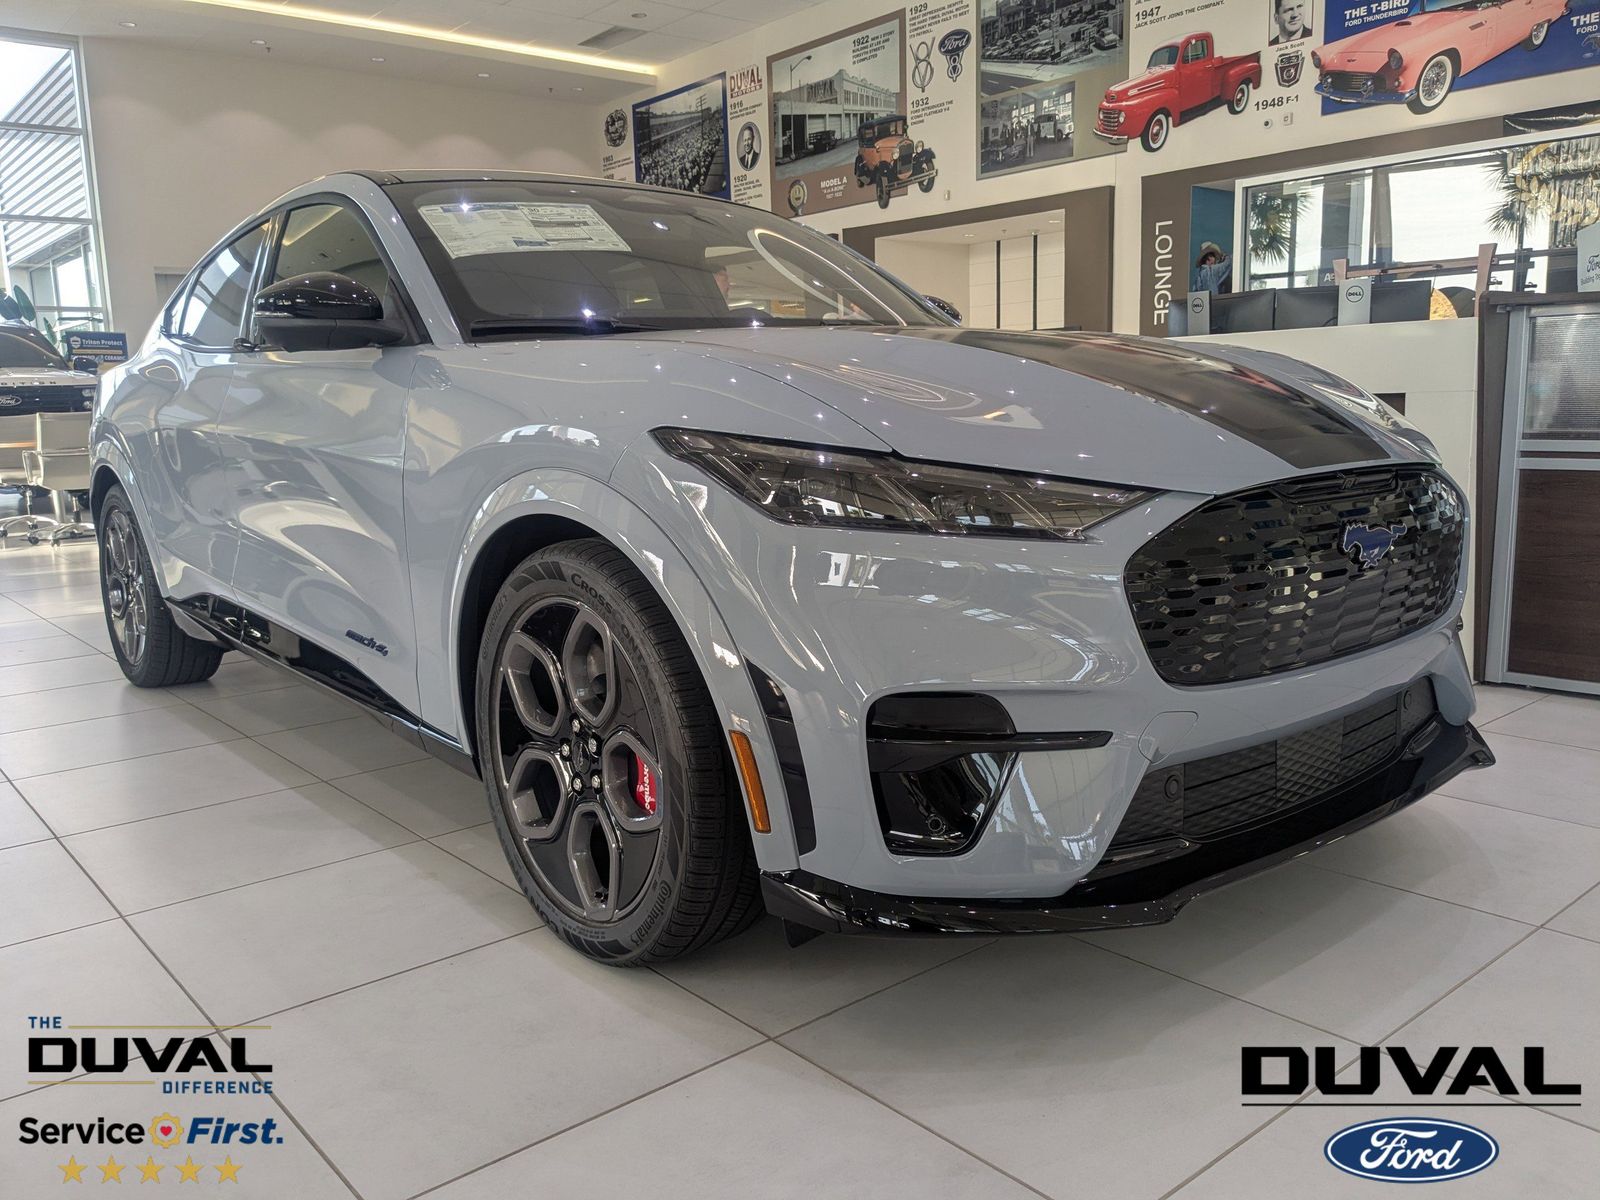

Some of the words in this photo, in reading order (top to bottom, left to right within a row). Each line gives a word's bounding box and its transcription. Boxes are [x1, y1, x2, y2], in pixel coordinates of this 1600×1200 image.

[910, 2, 928, 15] 1929
[1135, 6, 1161, 21] 1947
[1344, 6, 1367, 19] THE
[1370, 0, 1410, 13] T-BIRD
[1135, 21, 1148, 29] JACK
[1149, 15, 1166, 25] SCOTT
[1167, 11, 1184, 20] JOINS
[1185, 7, 1196, 15] THE
[1345, 18, 1362, 27] FORD
[1364, 8, 1408, 22] THUNDERBIRD
[1570, 12, 1600, 27] THE
[910, 25, 927, 33] COMPANY
[1576, 25, 1598, 35] FORD
[852, 35, 870, 47] 1922
[940, 34, 969, 52] Ford
[1290, 41, 1305, 49] Scott
[729, 65, 763, 92] DUVAL
[730, 100, 744, 110] 1916
[911, 97, 930, 109] 1932
[1254, 96, 1284, 111] 1948
[1286, 94, 1299, 105] F-1
[733, 173, 748, 184] 1920
[820, 178, 842, 189] MODEL
[842, 176, 848, 184] A
[1153, 220, 1173, 326] LOUNGE
